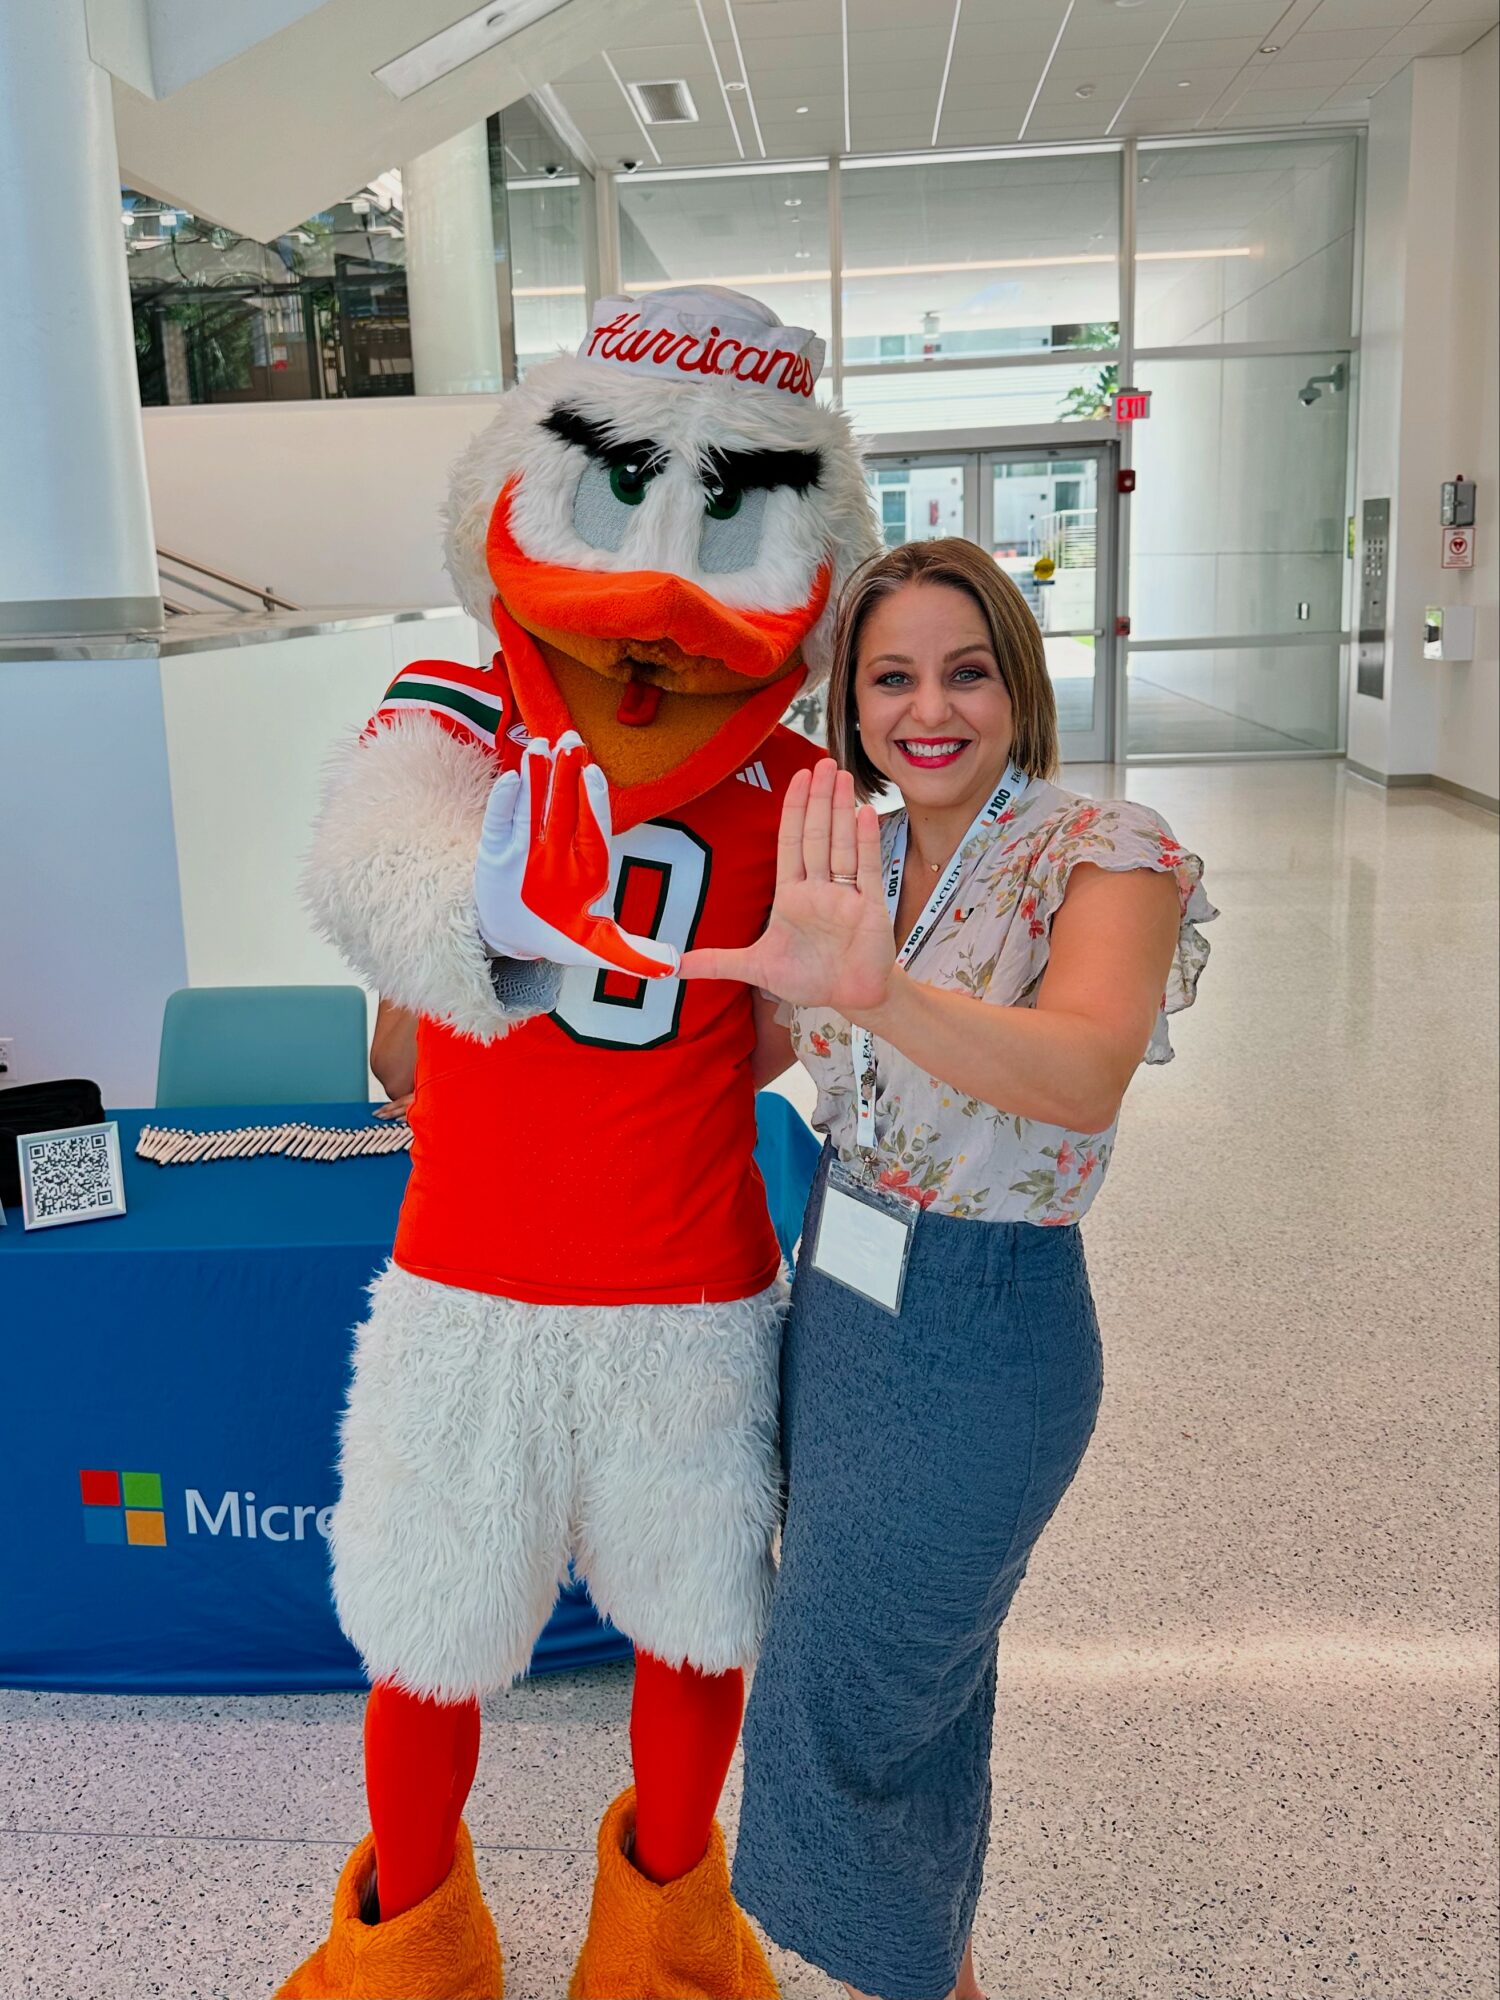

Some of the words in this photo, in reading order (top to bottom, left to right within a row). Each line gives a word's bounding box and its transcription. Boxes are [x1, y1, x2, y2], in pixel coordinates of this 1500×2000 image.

[587, 313, 815, 398] Hurricanes
[1117, 396, 1146, 420] EXIT
[547, 817, 713, 1051] 0
